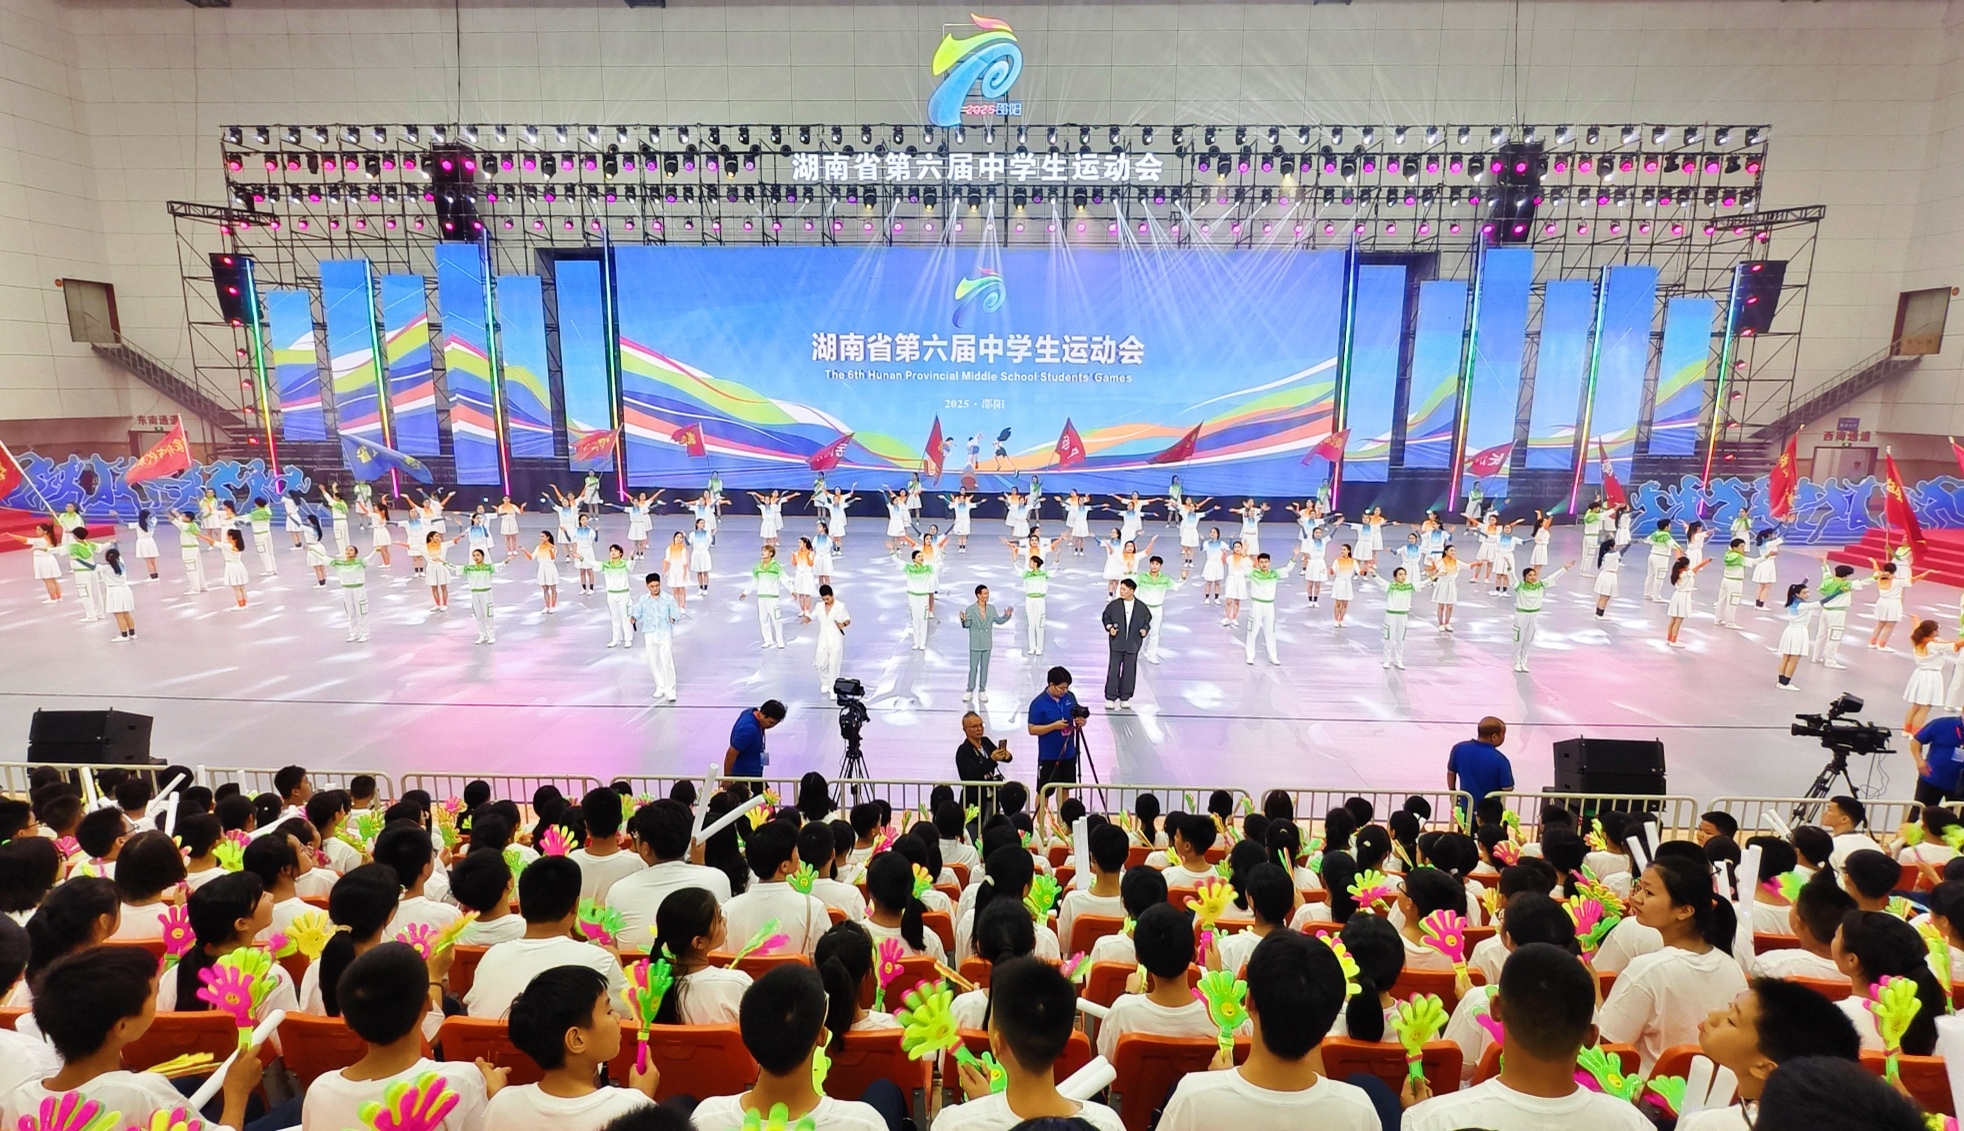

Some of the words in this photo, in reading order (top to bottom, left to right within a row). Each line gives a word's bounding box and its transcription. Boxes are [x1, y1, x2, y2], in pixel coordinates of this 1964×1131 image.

[791, 152, 1164, 182] 湖南省第六届中学生运动会
[811, 332, 1145, 366] 湖南省第六届中学生运动会
[825, 370, 844, 380] The
[847, 370, 865, 380] 6th
[868, 370, 903, 380] Hunan
[905, 370, 959, 381] Provincial
[961, 371, 997, 381] Middle
[1000, 371, 1037, 382] School
[1094, 373, 1133, 383] Games
[944, 399, 970, 408] 2025
[1823, 430, 1871, 442] 西南通道
